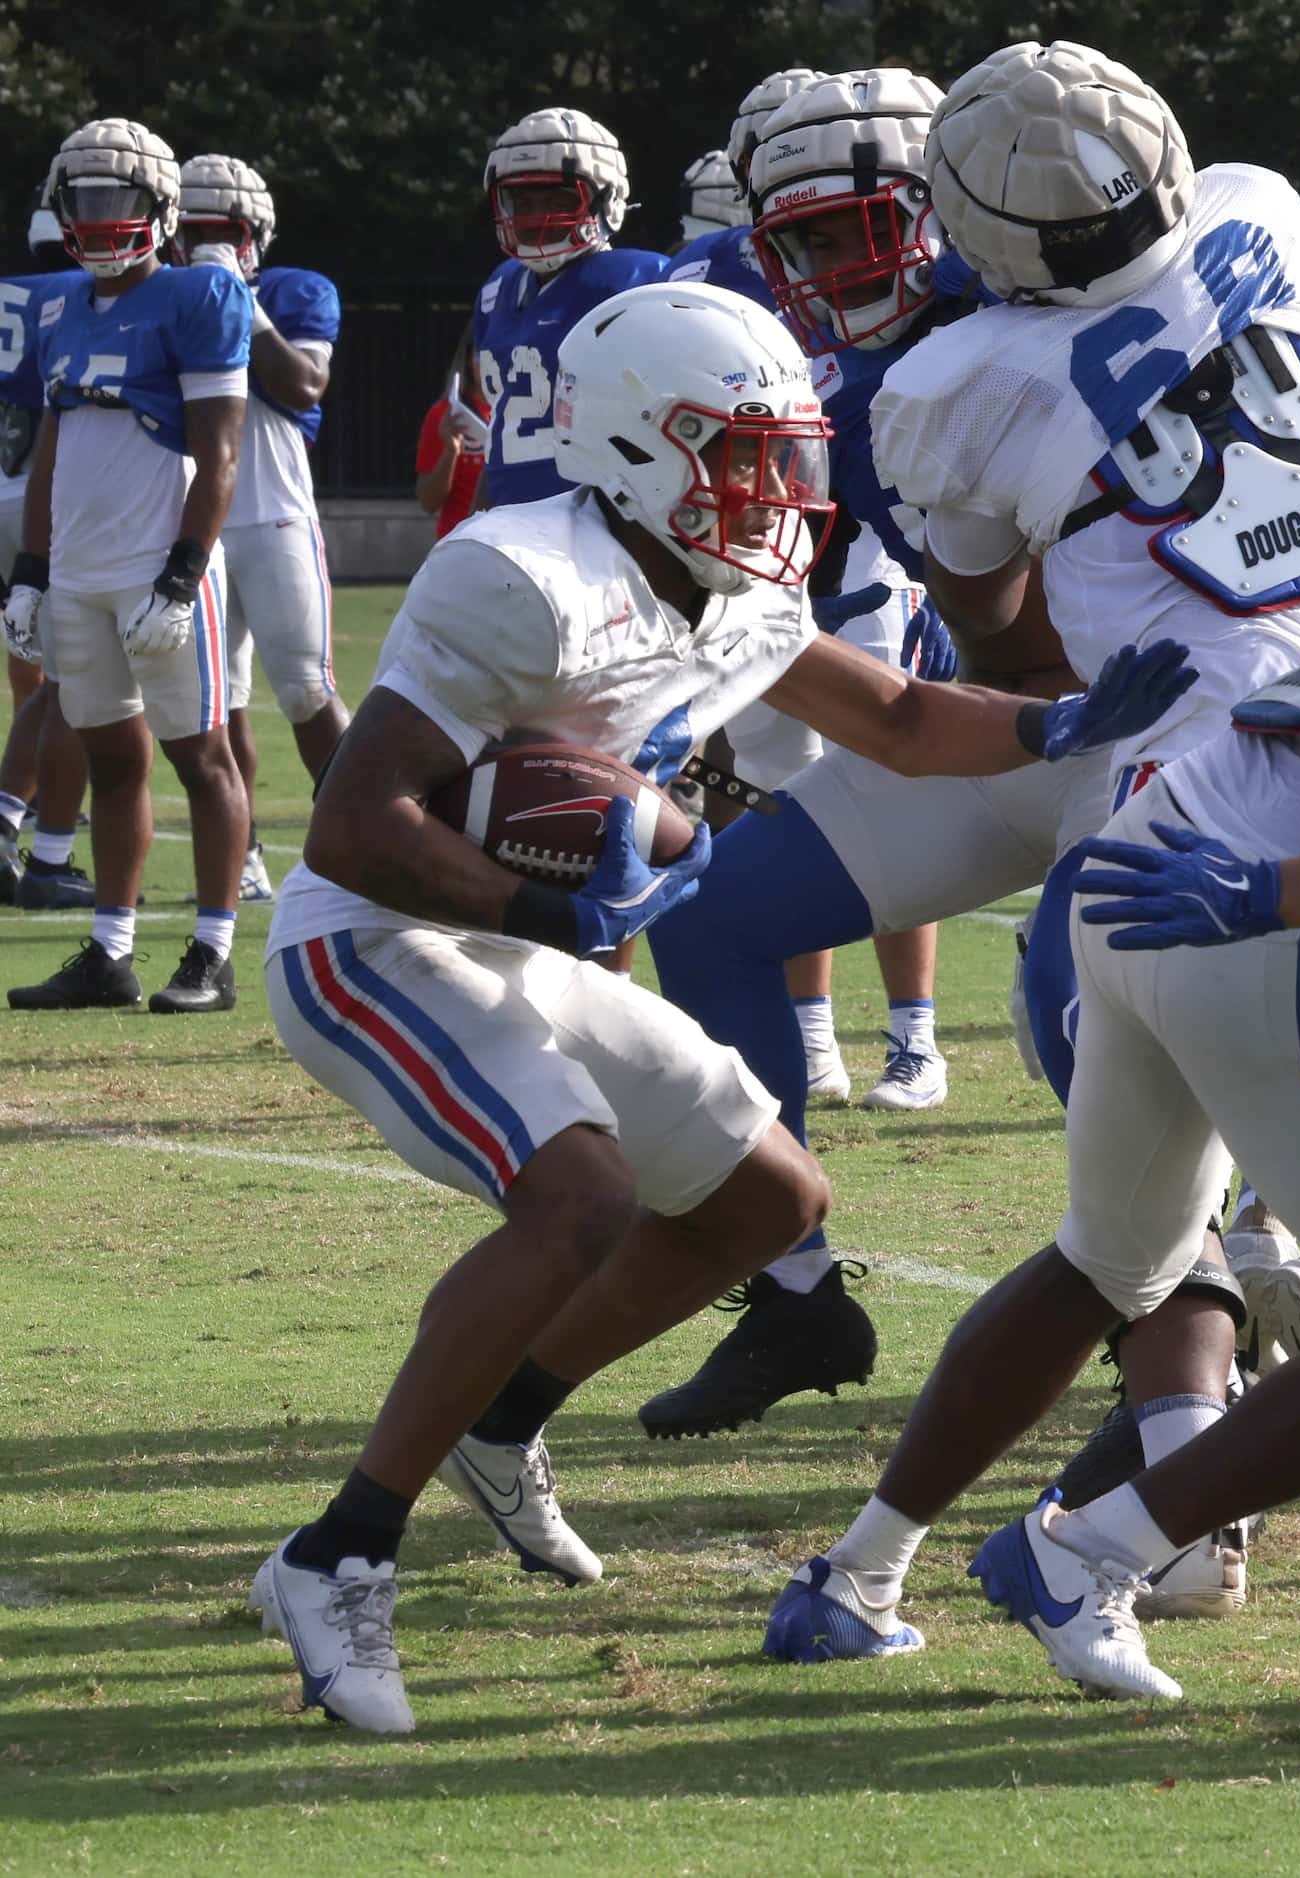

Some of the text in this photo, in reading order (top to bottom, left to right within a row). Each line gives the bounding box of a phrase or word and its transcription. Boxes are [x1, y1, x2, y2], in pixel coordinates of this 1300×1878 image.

[774, 185, 818, 209] Riddell
[721, 372, 748, 387] SMU
[1190, 1268, 1231, 1282] NJOY
